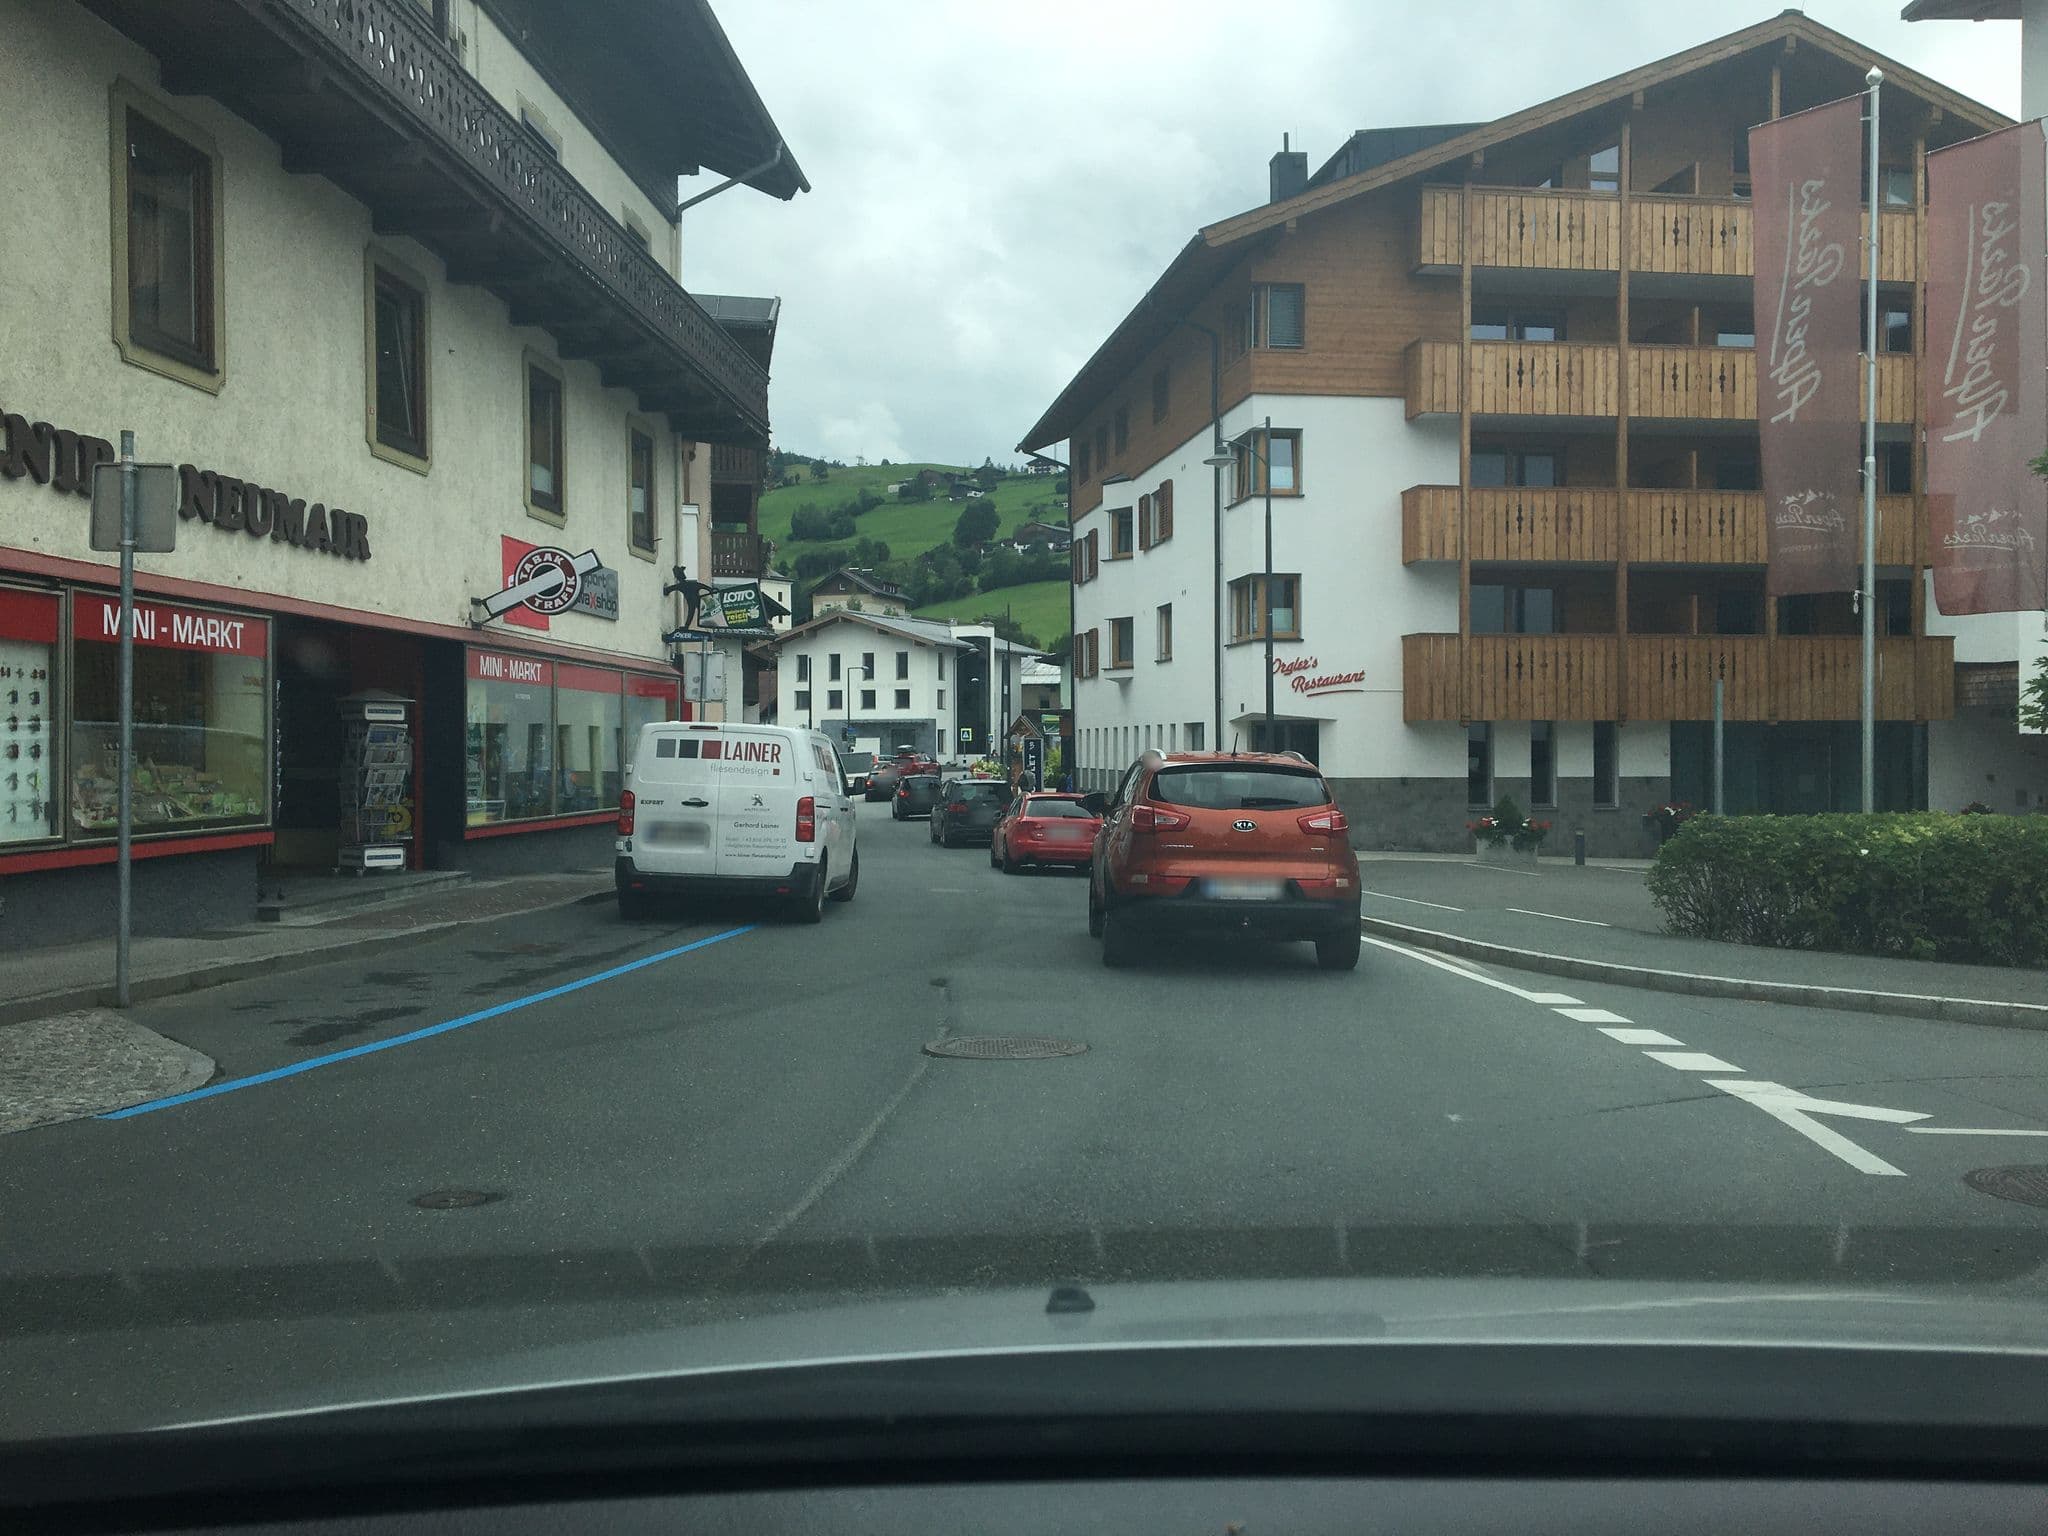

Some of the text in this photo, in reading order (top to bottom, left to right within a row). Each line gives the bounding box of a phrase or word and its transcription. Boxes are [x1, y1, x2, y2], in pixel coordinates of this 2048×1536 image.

[178, 464, 371, 560] NEUMAIR
[520, 552, 564, 580] TABAK
[534, 575, 576, 609] TRAFIK
[722, 589, 756, 604] LOTTO
[103, 603, 155, 640] MNI
[173, 613, 244, 649] MARKT
[480, 655, 503, 677] MINI
[509, 659, 542, 682] MARKT
[1291, 669, 1366, 693] Restaurant
[724, 741, 781, 763] LAINER
[710, 763, 769, 776] fliesendesign
[733, 821, 760, 829] Gerhard
[1236, 821, 1254, 830] KIA
